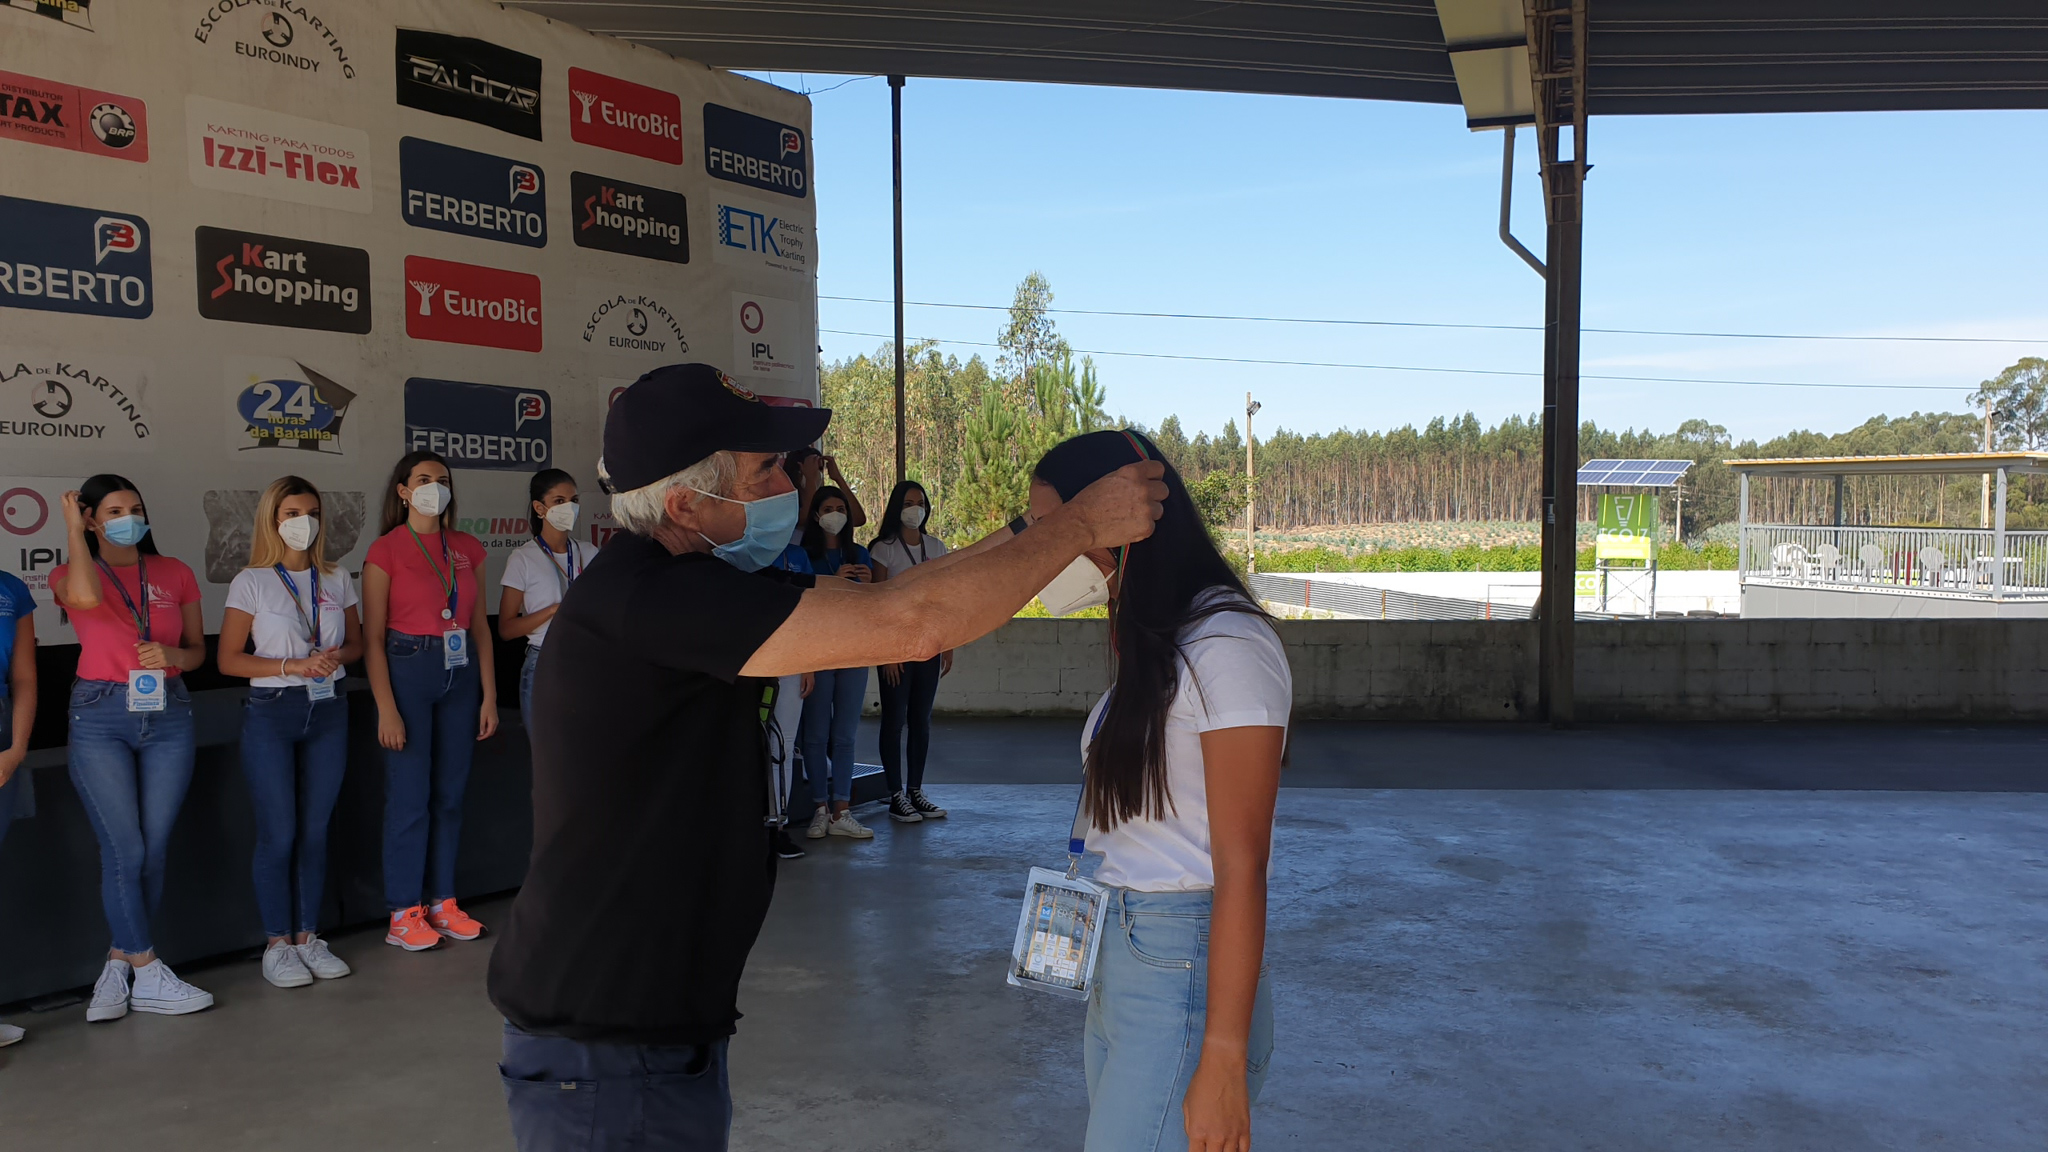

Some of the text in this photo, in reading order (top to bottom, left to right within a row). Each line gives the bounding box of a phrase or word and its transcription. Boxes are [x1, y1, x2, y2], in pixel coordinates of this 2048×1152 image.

[280, 0, 356, 80] KARTING
[235, 41, 320, 73] EUROINDY
[1, 83, 63, 101] DISTRIBUTOR
[409, 57, 538, 111] PALOCAR
[15, 123, 66, 139] PRODUCTS
[108, 127, 135, 138] BRP
[601, 100, 680, 141] EuroBic
[207, 123, 355, 160] KARTING PARA TODOS
[203, 136, 361, 190] Izzi-Flex
[709, 146, 804, 190] FERBERTO
[408, 189, 542, 238] FERBERTO
[601, 185, 645, 213] Kart
[581, 195, 680, 245] Shopping
[723, 205, 804, 257] ETK Electric
[243, 242, 307, 274] Kart
[779, 234, 804, 250] Trophy
[780, 249, 805, 265] Karting
[211, 254, 359, 312] Shopping
[443, 289, 539, 326] EuroBic
[583, 295, 627, 343] ESCOLA
[638, 295, 690, 354] KARTING
[609, 336, 666, 352] EUROINDY
[751, 341, 774, 360] IPL
[35, 367, 51, 375] DE
[56, 362, 150, 439] KARTING
[253, 382, 316, 421] 24
[0, 420, 106, 438] EUROINDY
[250, 425, 333, 440] da Batalha
[268, 412, 307, 426] horas
[412, 430, 548, 463] FERBERTO
[455, 517, 528, 535] ROIND
[593, 512, 614, 520] KAR
[491, 538, 503, 548] da
[1599, 528, 1648, 543] ECO 7
[1577, 576, 1597, 590] CO
